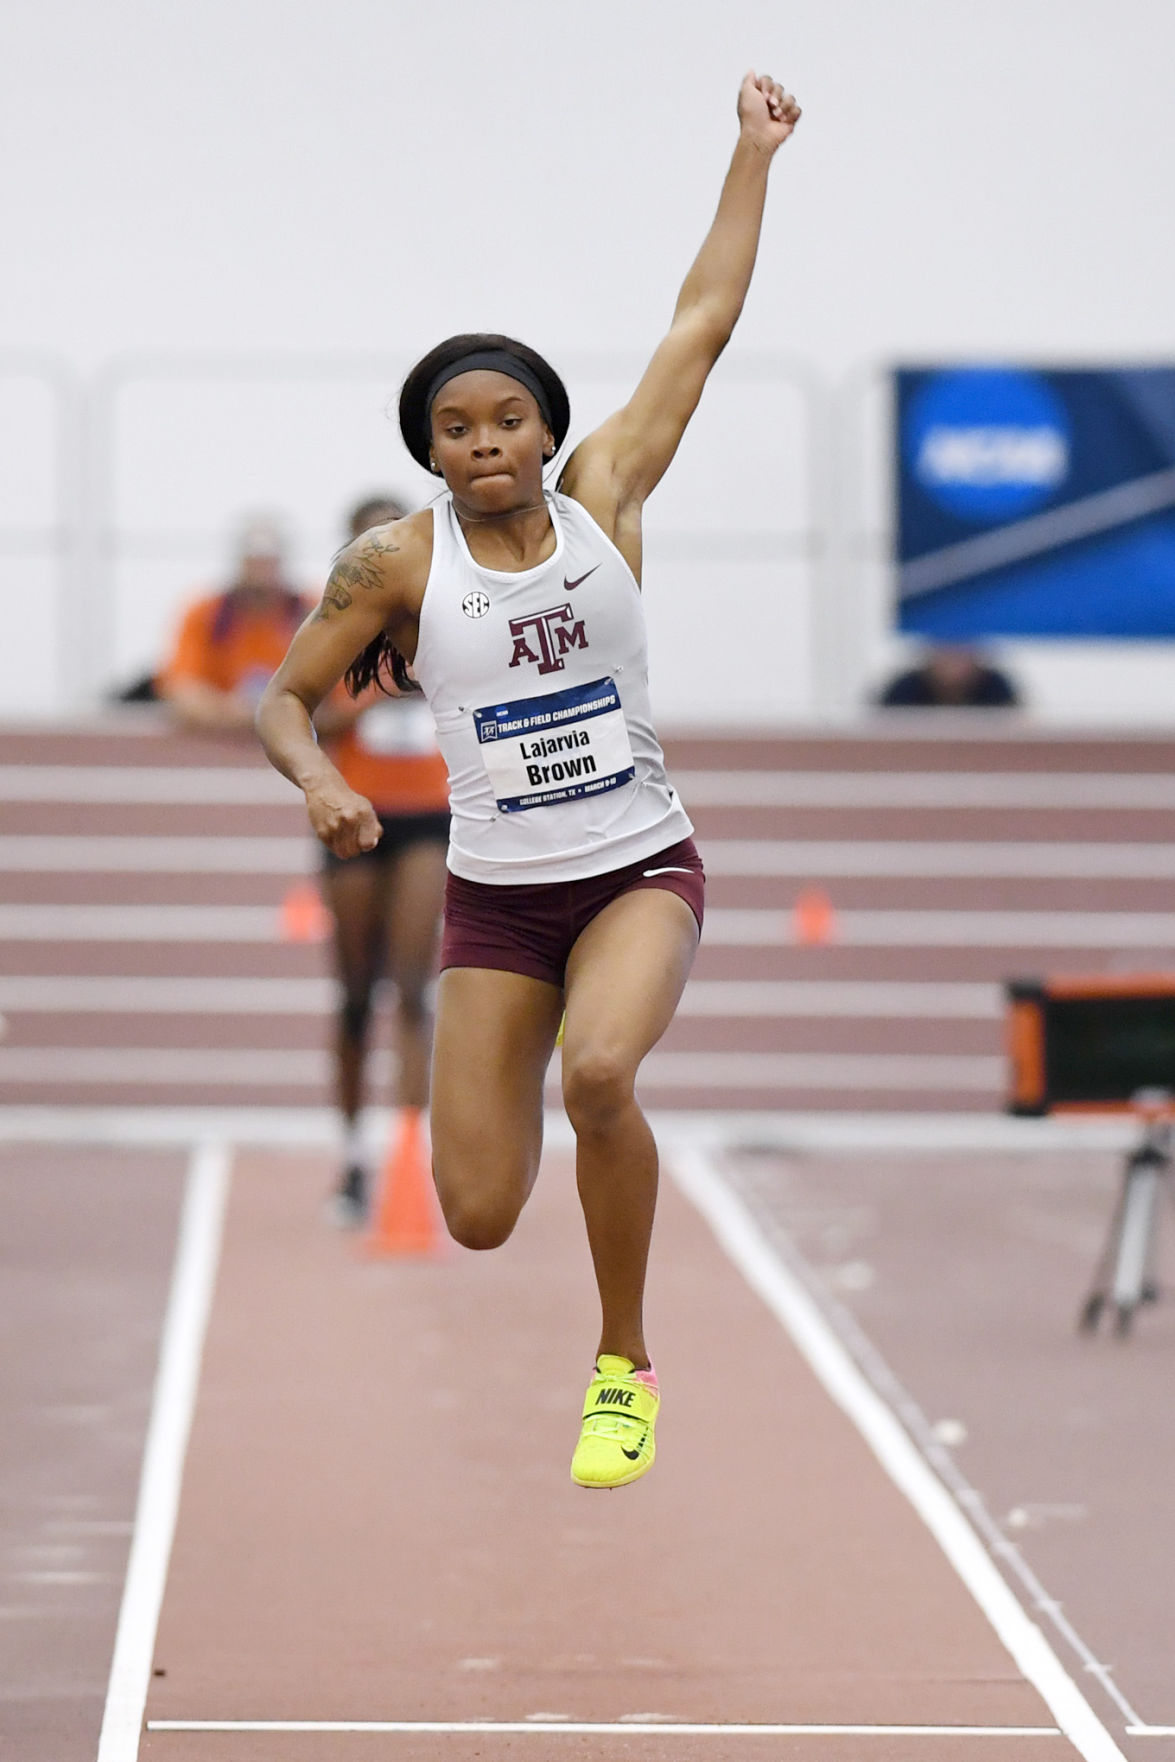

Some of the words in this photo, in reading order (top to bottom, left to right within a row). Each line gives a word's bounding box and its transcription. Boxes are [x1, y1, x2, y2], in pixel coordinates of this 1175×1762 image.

[462, 591, 490, 619] SEC
[498, 719, 523, 733] TRACK
[530, 713, 551, 727] FIELD
[552, 694, 616, 721] CHAMPIONSHIPS
[519, 730, 591, 760] Lajarvia
[526, 754, 597, 786] Brown
[595, 1388, 636, 1408] NIKE
